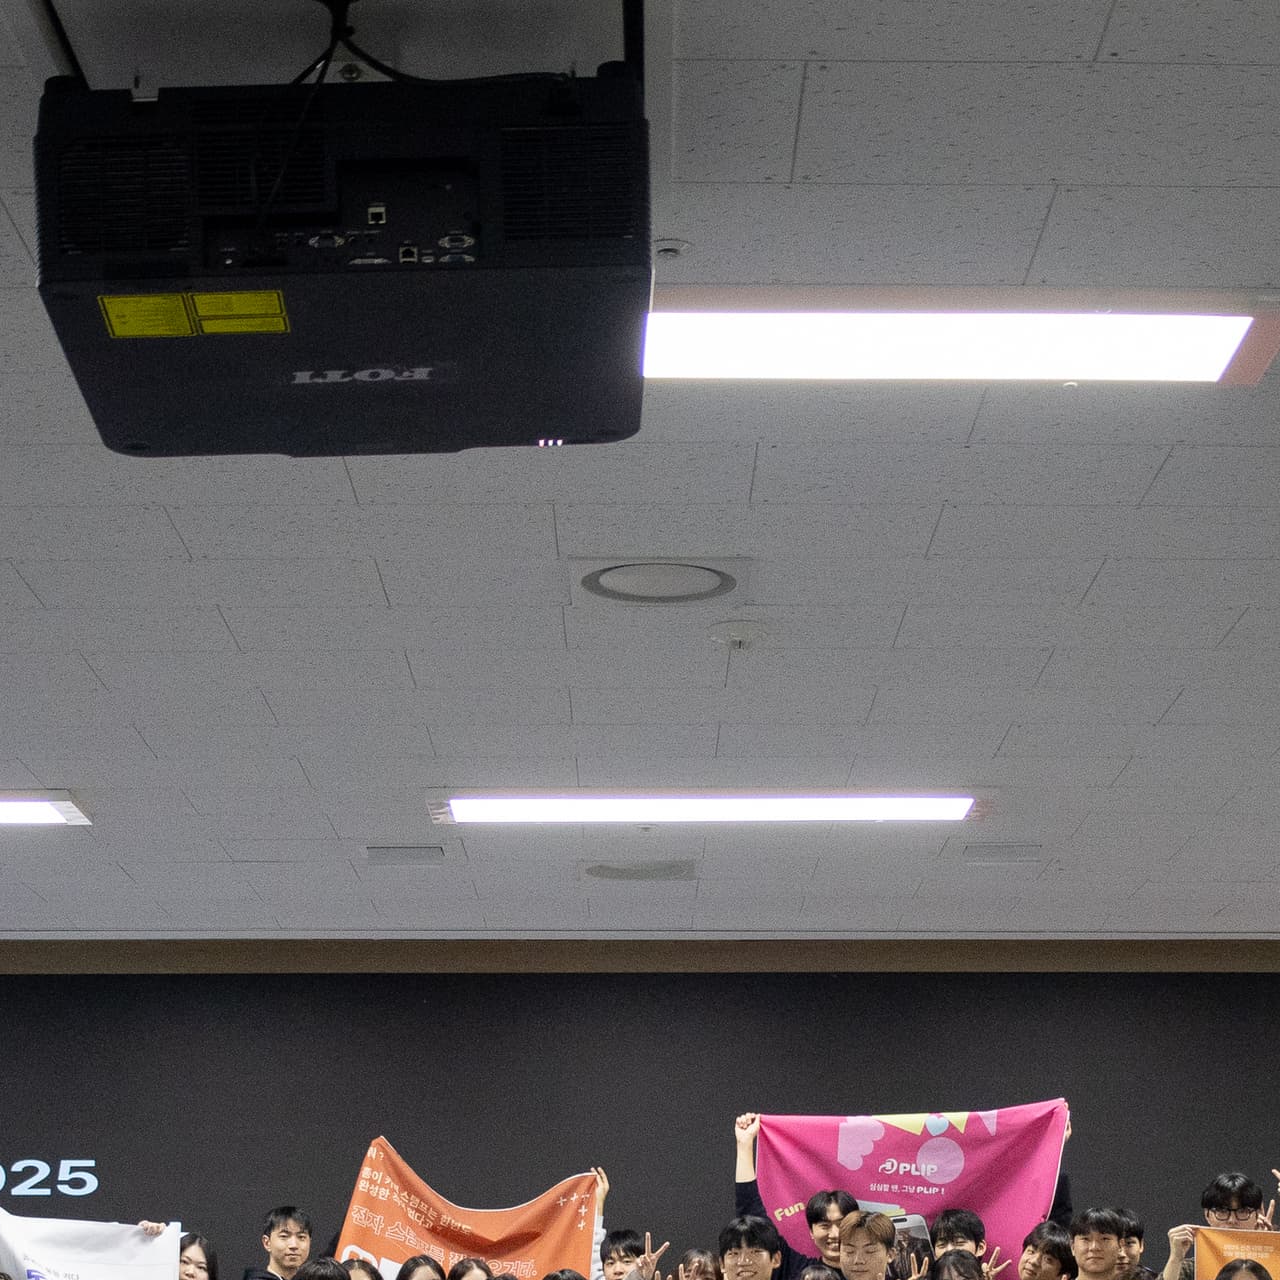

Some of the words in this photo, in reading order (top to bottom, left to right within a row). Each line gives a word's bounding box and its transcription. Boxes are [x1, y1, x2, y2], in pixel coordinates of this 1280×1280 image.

[898, 1163, 938, 1177] PLIP
[358, 1178, 392, 1201] 완성한
[916, 1186, 939, 1195] PLIP
[350, 1204, 385, 1236] 전자
[774, 1201, 806, 1222] Fun
